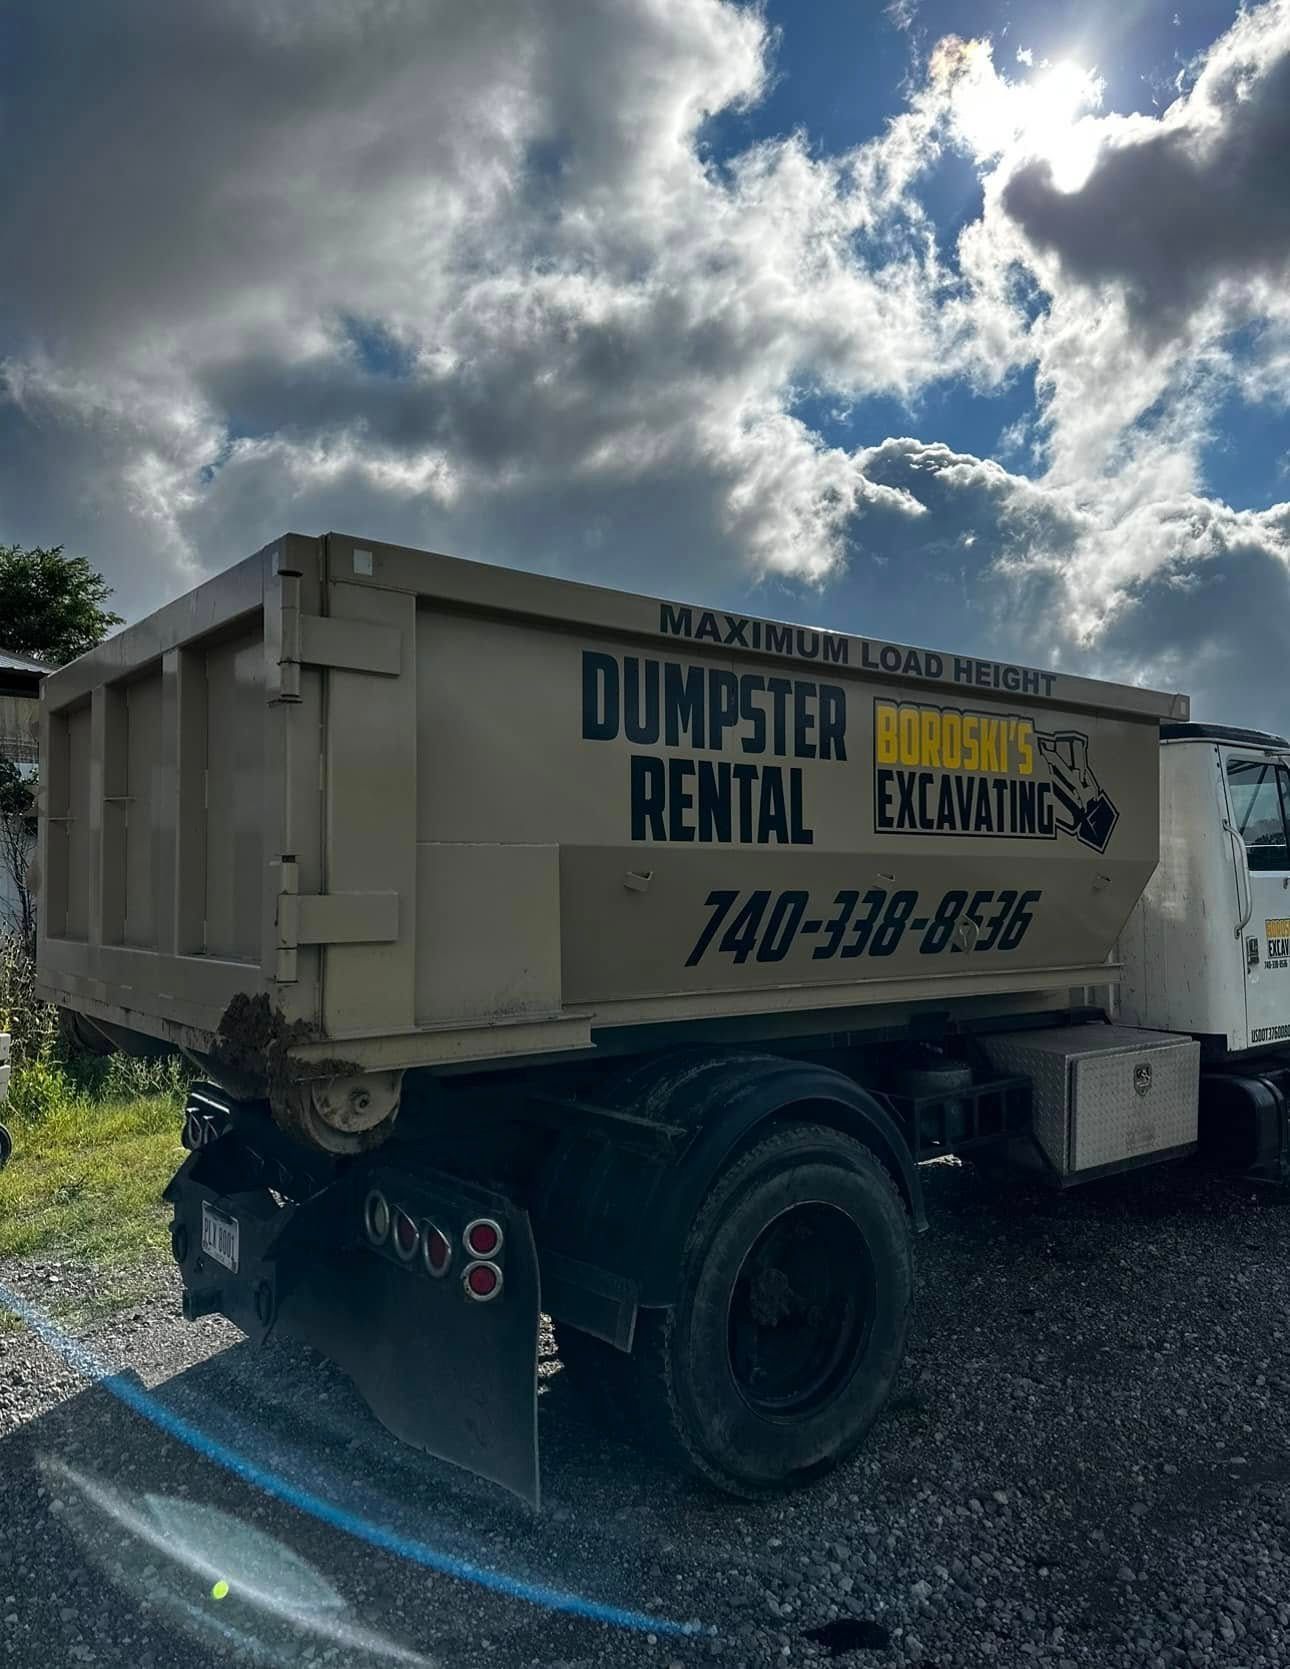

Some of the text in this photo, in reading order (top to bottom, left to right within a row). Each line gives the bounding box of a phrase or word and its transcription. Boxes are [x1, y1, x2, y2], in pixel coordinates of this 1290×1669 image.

[660, 604, 1057, 697] MAXIMUM LOAD HEIGHT
[582, 650, 847, 761] DUMPSTER
[877, 703, 1034, 776] BOROSKI'S
[631, 755, 814, 845] RENTAL
[877, 768, 1055, 835] EXCAVATING
[684, 889, 1042, 967] 740-338-8536
